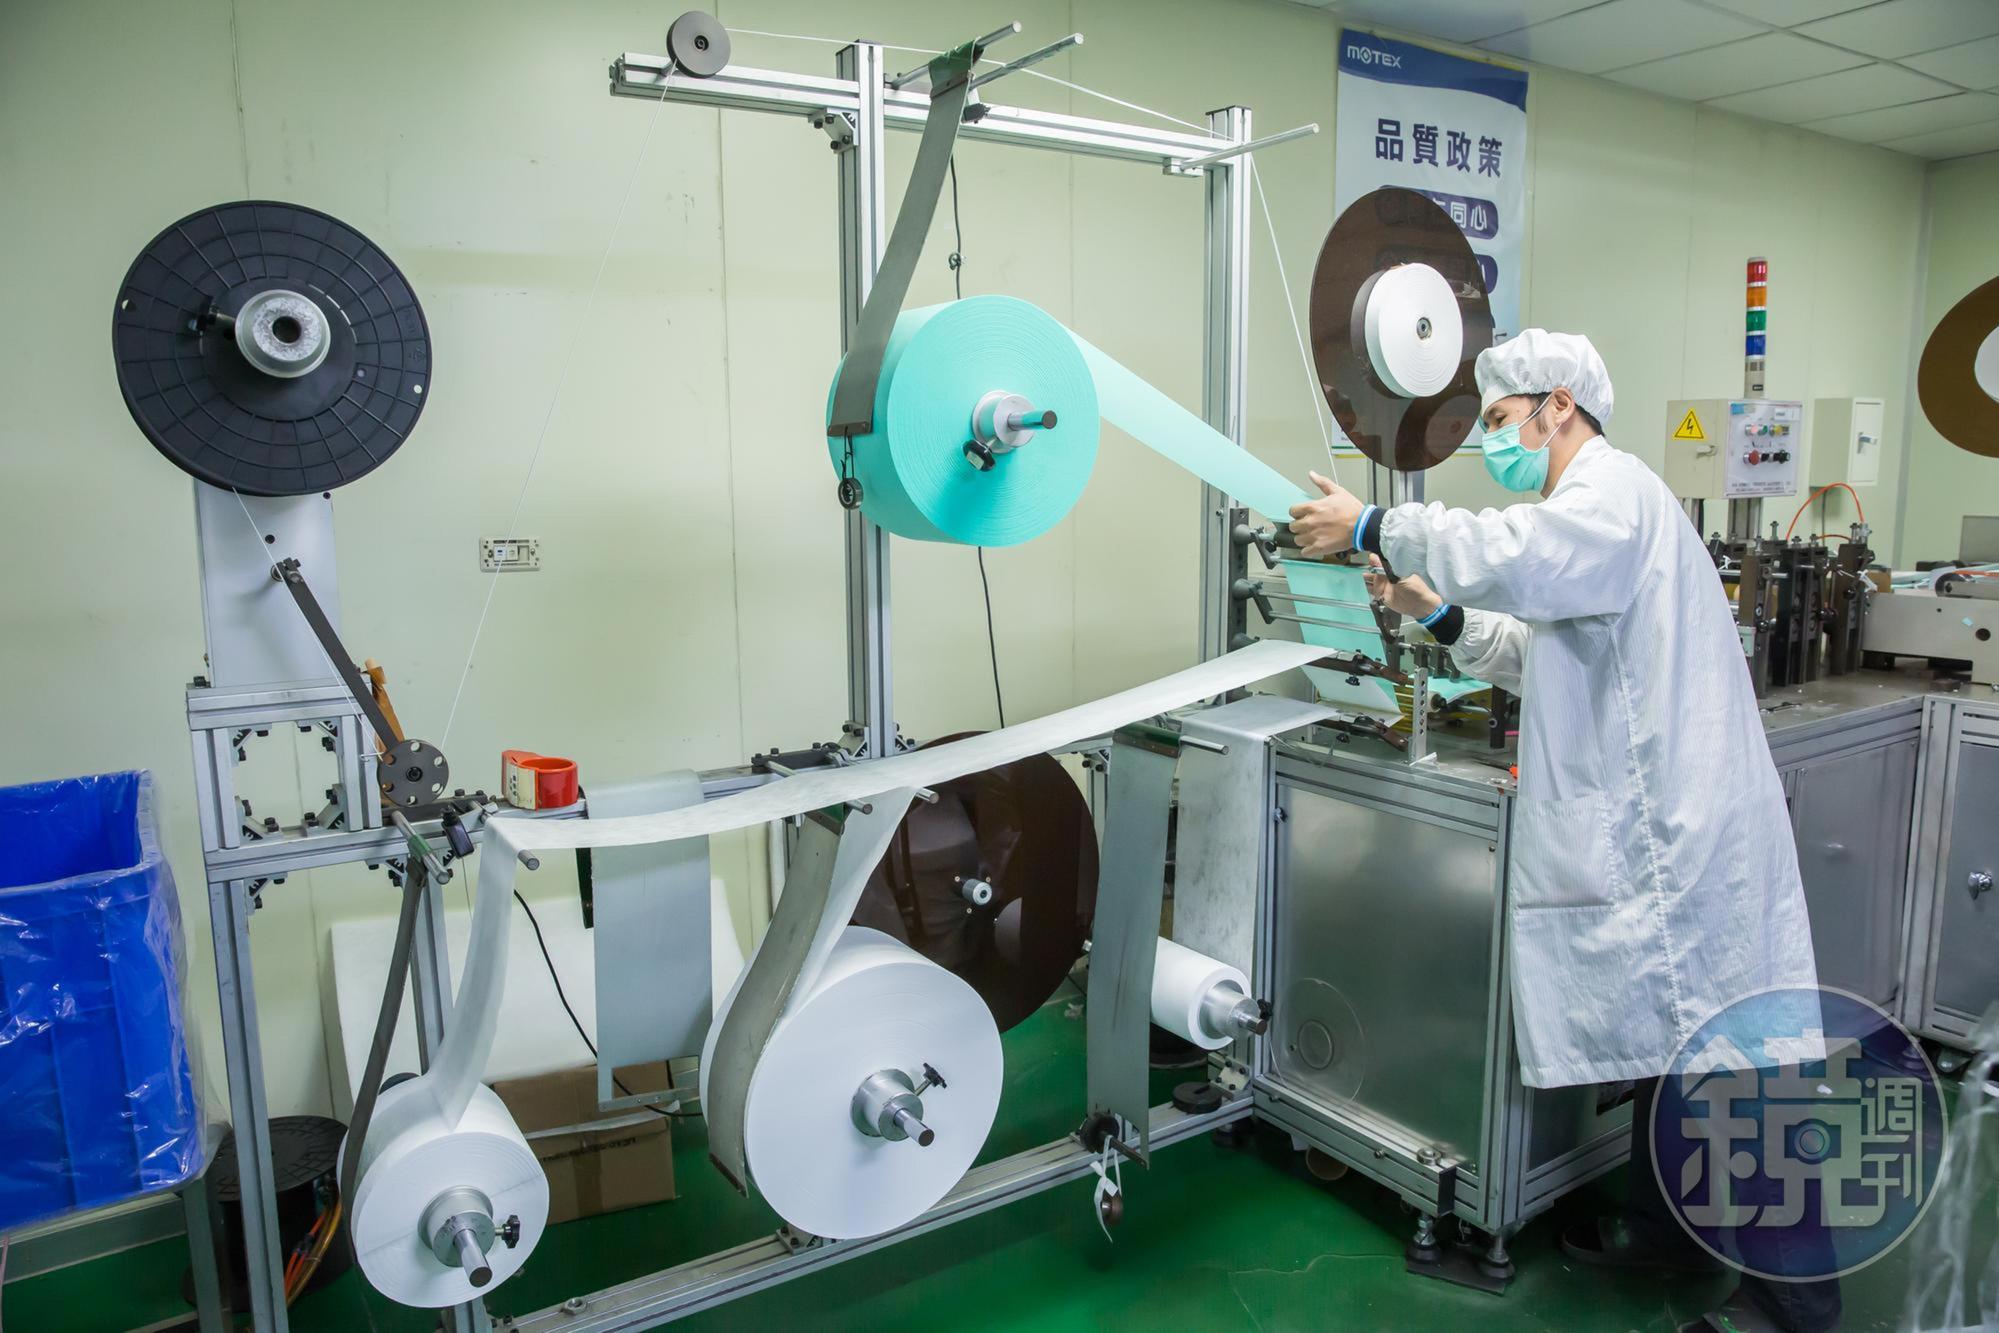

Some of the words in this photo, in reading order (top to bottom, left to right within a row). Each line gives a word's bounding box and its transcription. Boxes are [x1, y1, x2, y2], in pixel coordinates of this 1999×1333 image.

[1375, 118, 1503, 178] 品質政策
[1432, 197, 1488, 231] 同心
